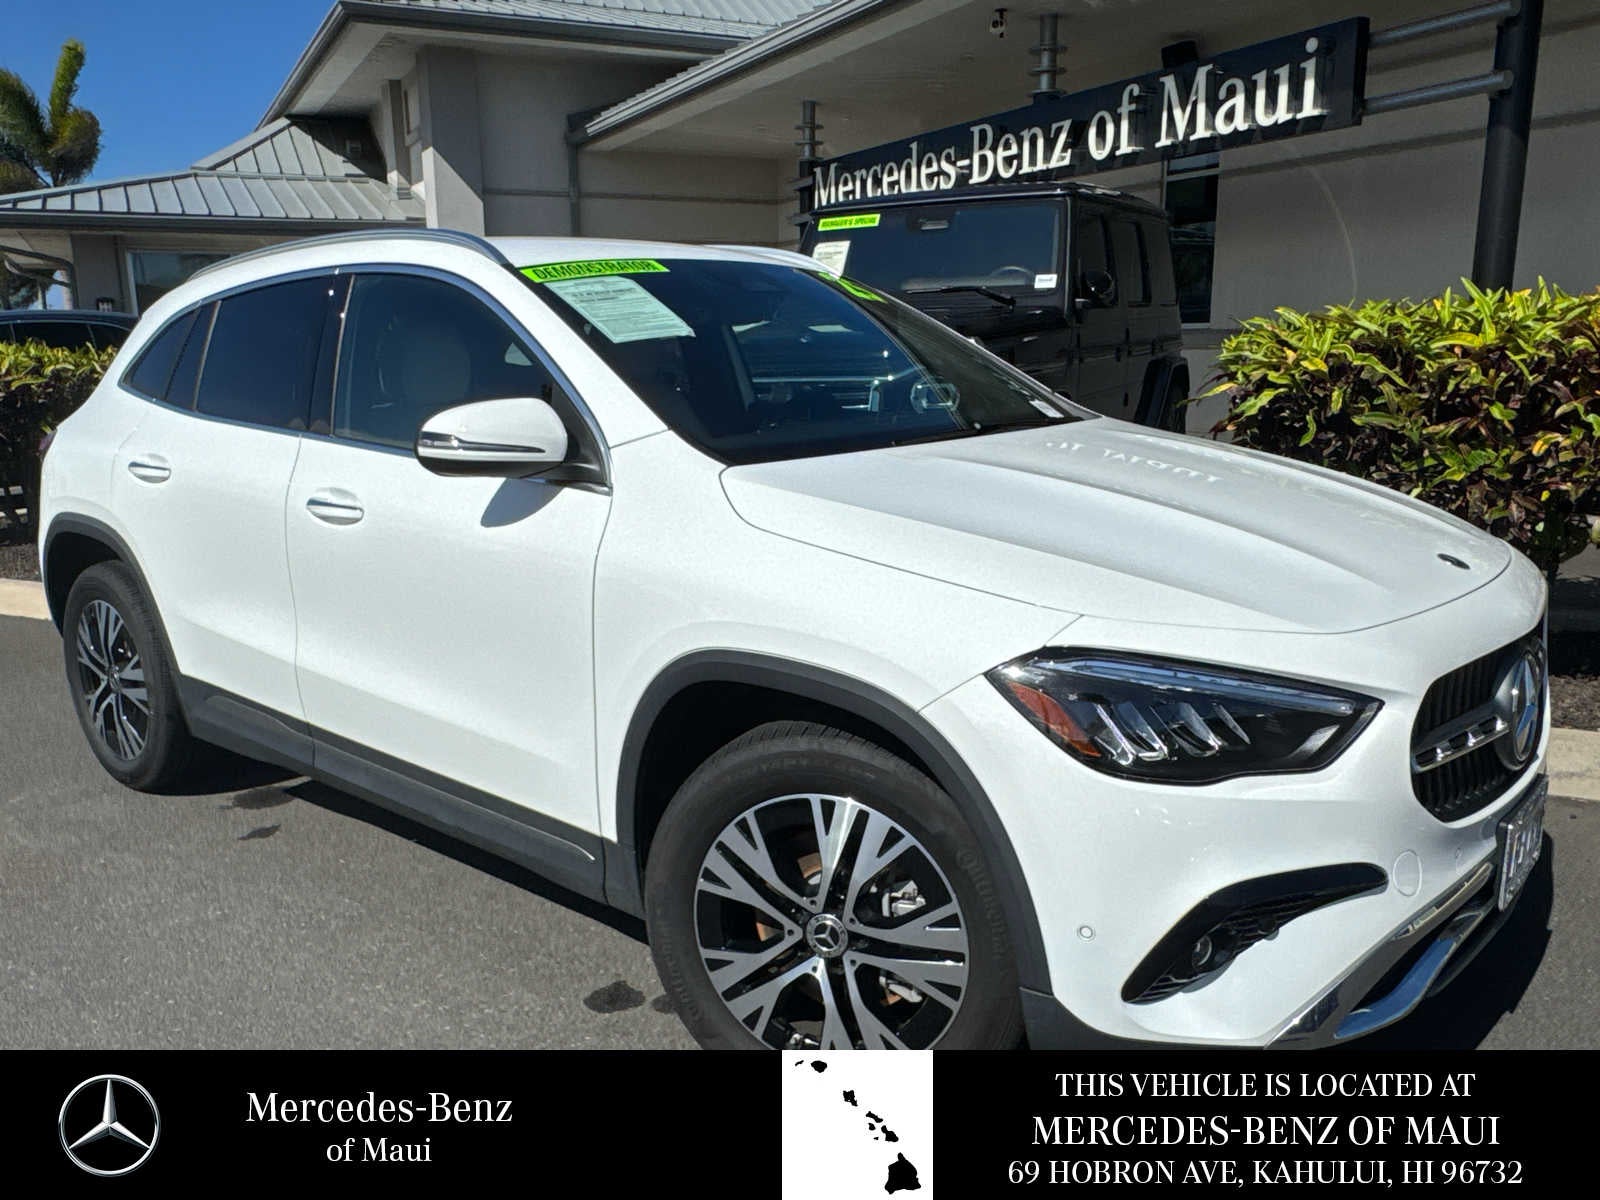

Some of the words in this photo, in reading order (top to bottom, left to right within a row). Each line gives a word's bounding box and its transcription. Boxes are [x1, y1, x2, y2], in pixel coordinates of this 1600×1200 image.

[813, 118, 1073, 209] Mercedes-Benz
[1087, 83, 1143, 161] of
[1154, 36, 1326, 148] Maui
[532, 259, 658, 279] DEMONSTRATOR
